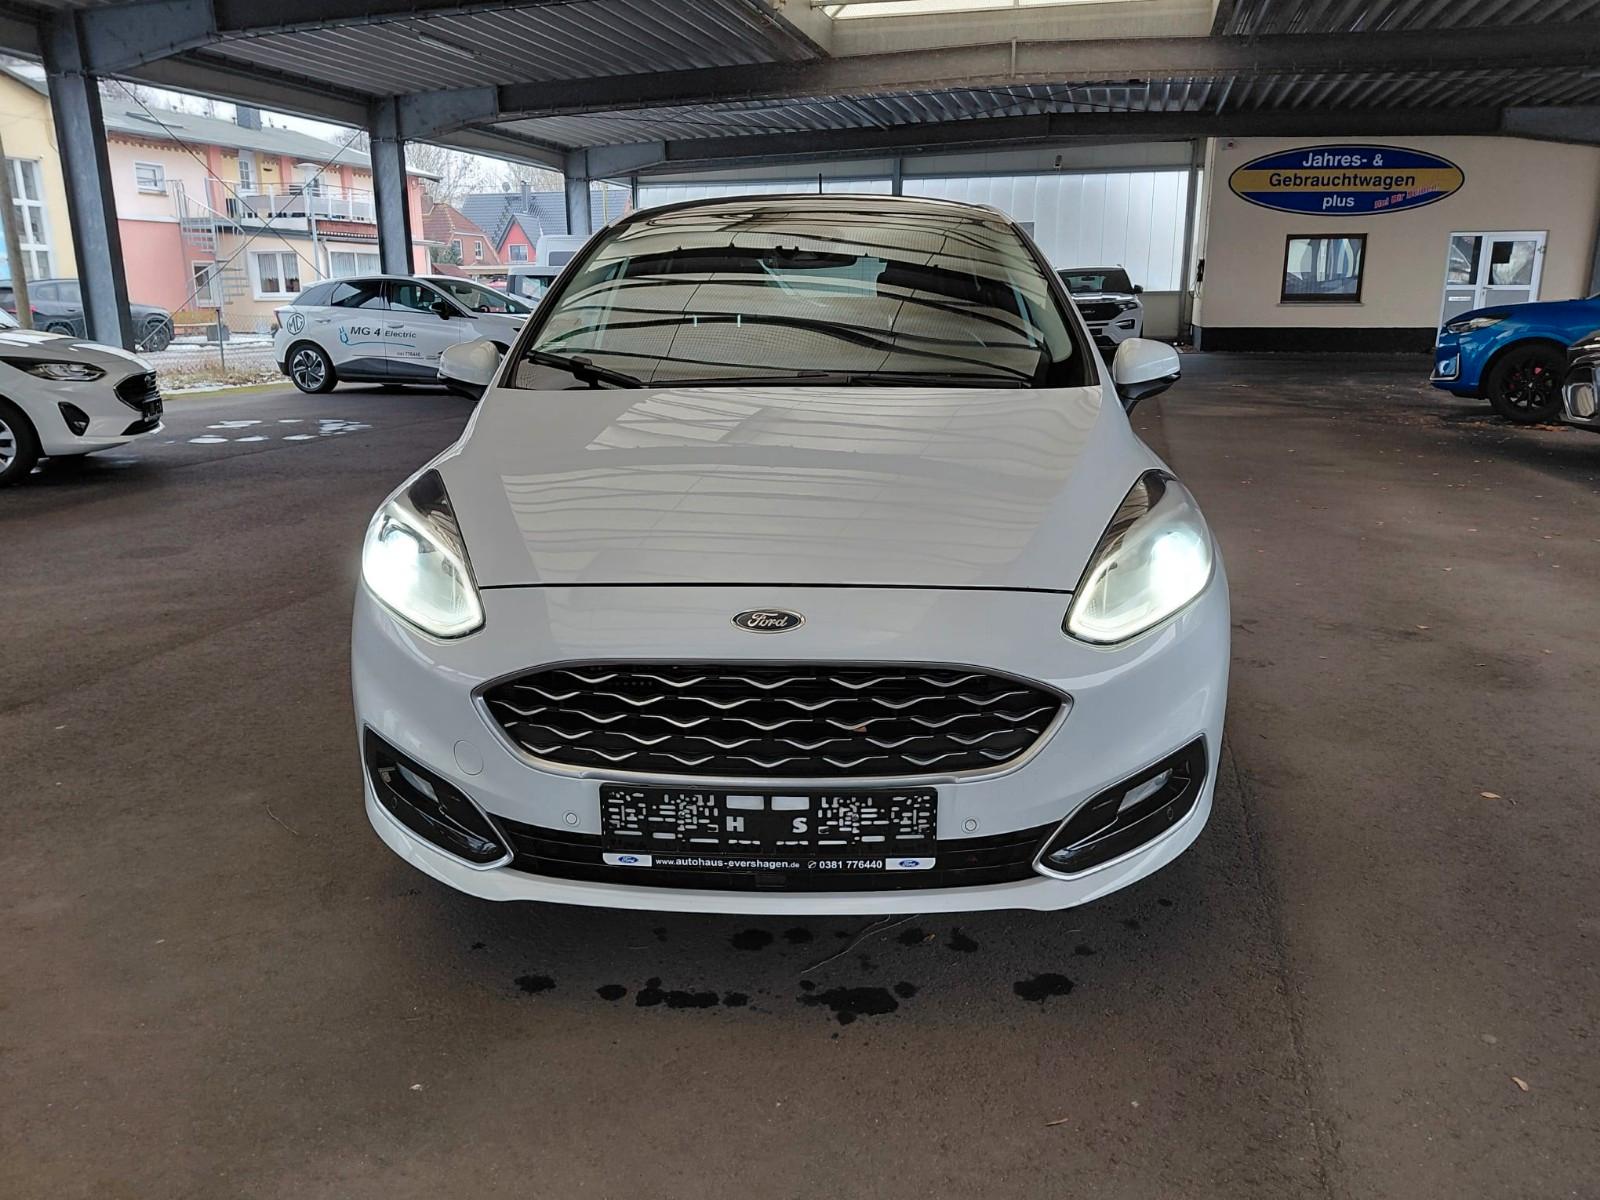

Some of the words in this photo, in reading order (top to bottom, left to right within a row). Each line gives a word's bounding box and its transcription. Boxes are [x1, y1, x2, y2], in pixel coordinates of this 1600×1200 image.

[1303, 153, 1367, 167] Jahres-
[1373, 153, 1384, 166] &
[1269, 173, 1415, 190] Gebrauchtwagen
[1322, 194, 1355, 210] plus
[288, 315, 304, 332] MG
[350, 326, 371, 336] MG
[374, 328, 381, 337] 4
[384, 330, 417, 339] Electric
[747, 612, 788, 627] Ford
[726, 816, 745, 832] H
[792, 817, 808, 833] S
[655, 857, 800, 869] www.autohaus-evershagen.de
[819, 860, 843, 869] 0381
[846, 860, 883, 869] 776440
